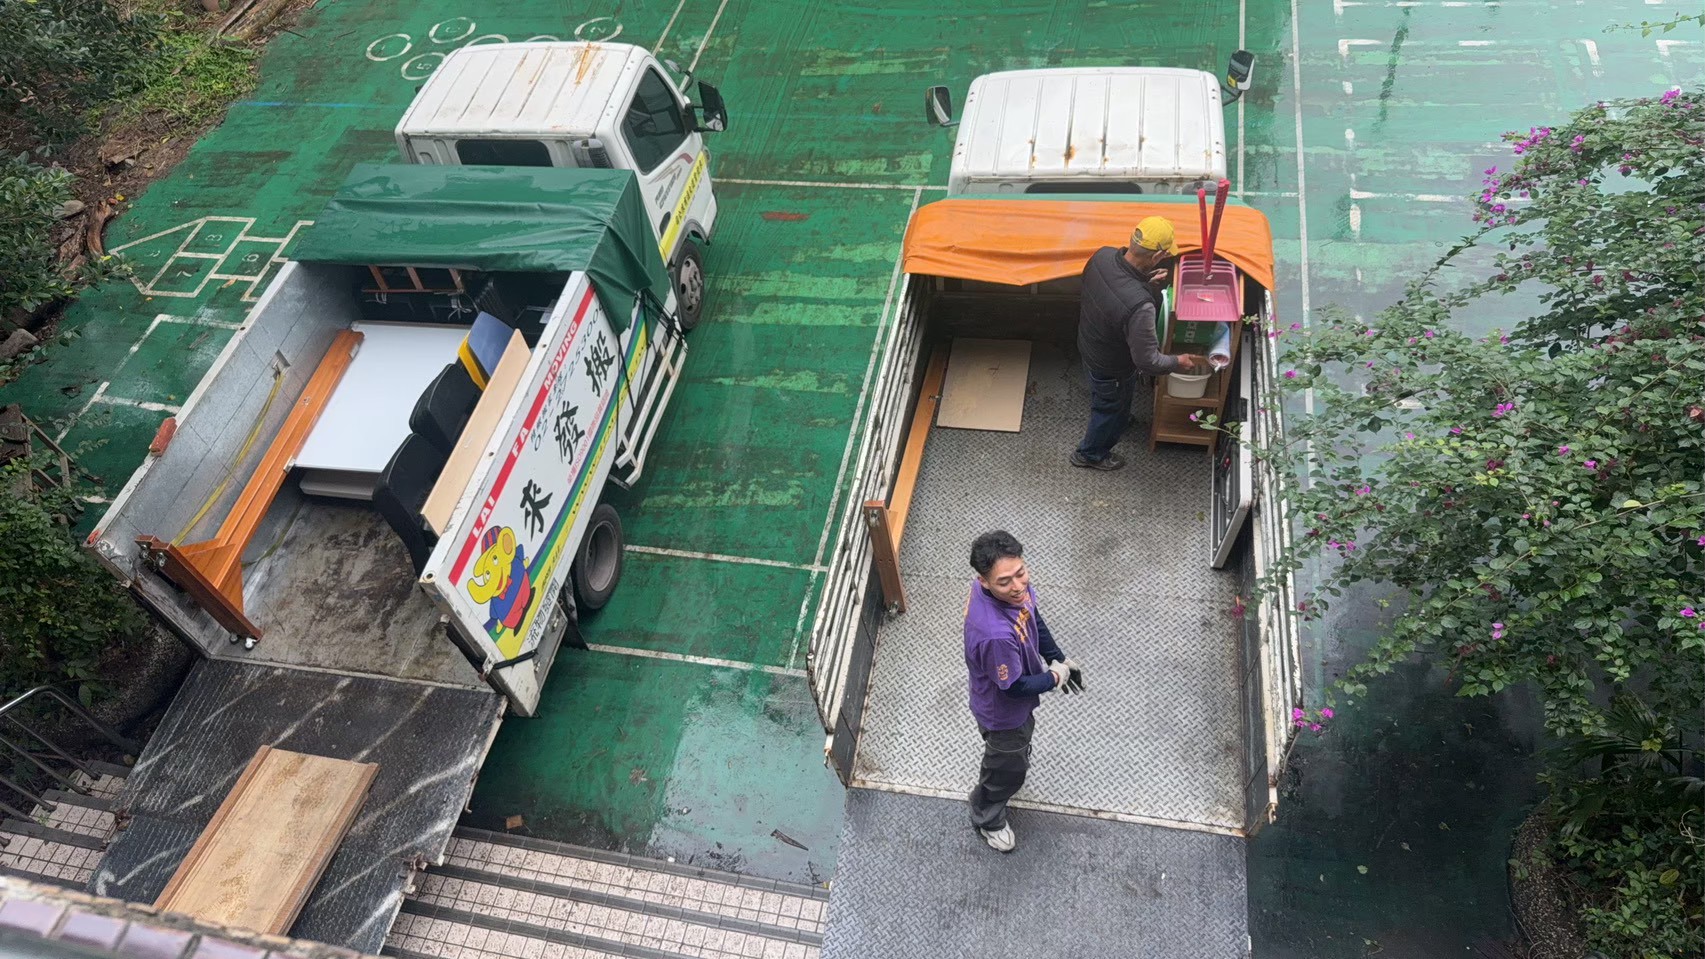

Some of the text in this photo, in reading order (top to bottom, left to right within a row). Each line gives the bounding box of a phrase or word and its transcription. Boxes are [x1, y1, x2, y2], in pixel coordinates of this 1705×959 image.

[472, 495, 496, 539] LAI
[511, 427, 529, 458] FA
[543, 321, 577, 390] MOVING
